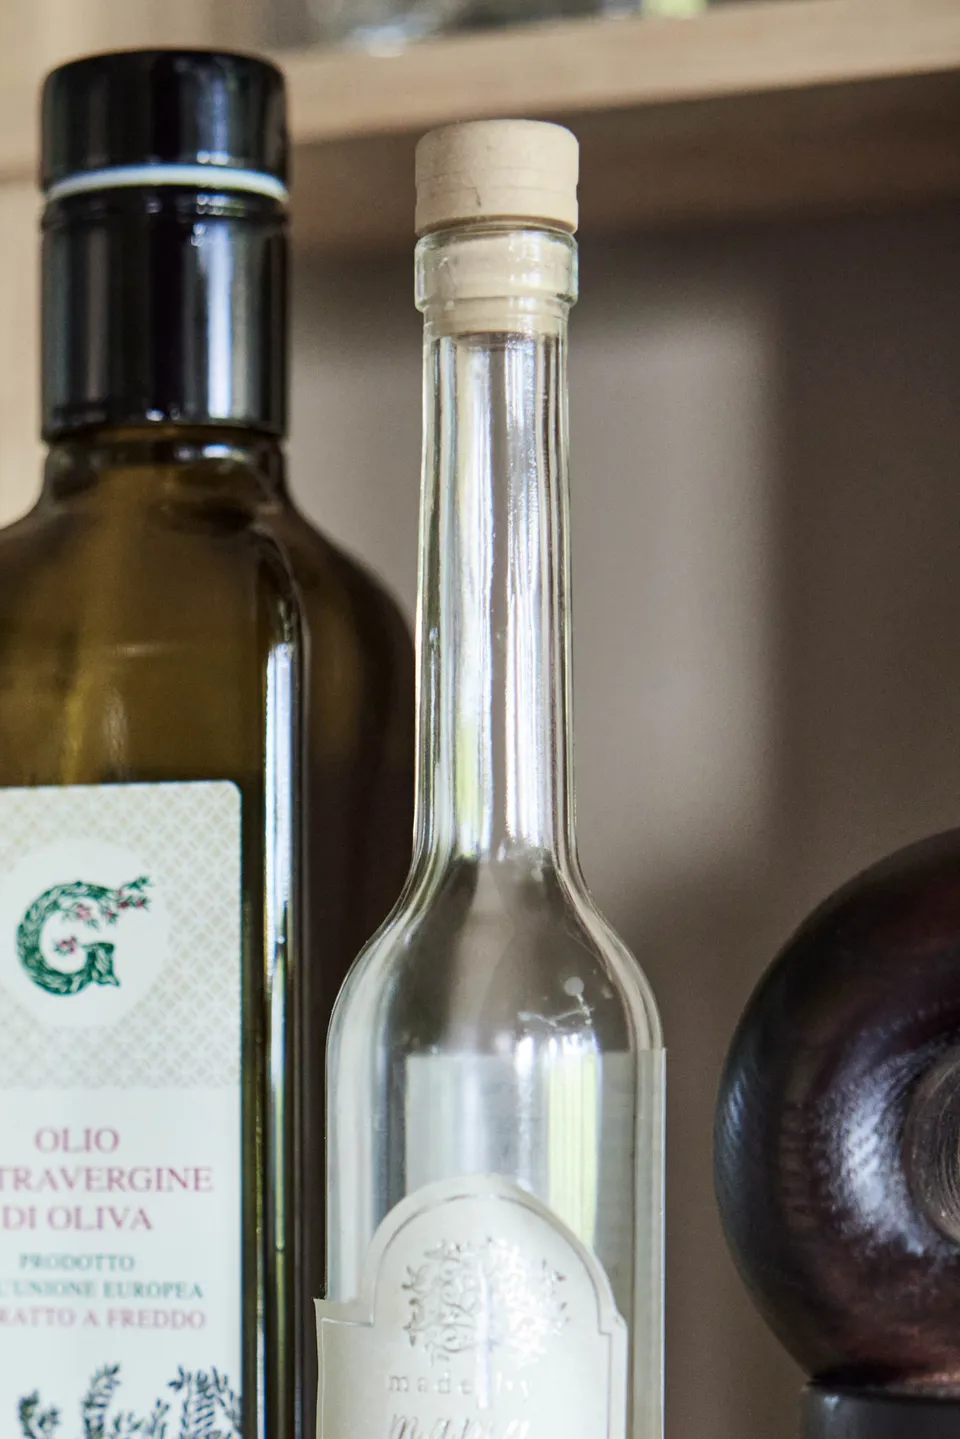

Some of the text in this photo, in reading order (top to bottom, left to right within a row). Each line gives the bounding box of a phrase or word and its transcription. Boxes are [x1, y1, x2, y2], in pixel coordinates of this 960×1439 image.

[35, 1127, 120, 1153] OLIO
[2, 1205, 153, 1231] DI OLIVA
[19, 1253, 136, 1272] PRODOTTO
[103, 1281, 204, 1299] EUROPEA
[83, 1309, 100, 1328] A
[106, 1308, 206, 1330] FREDDO
